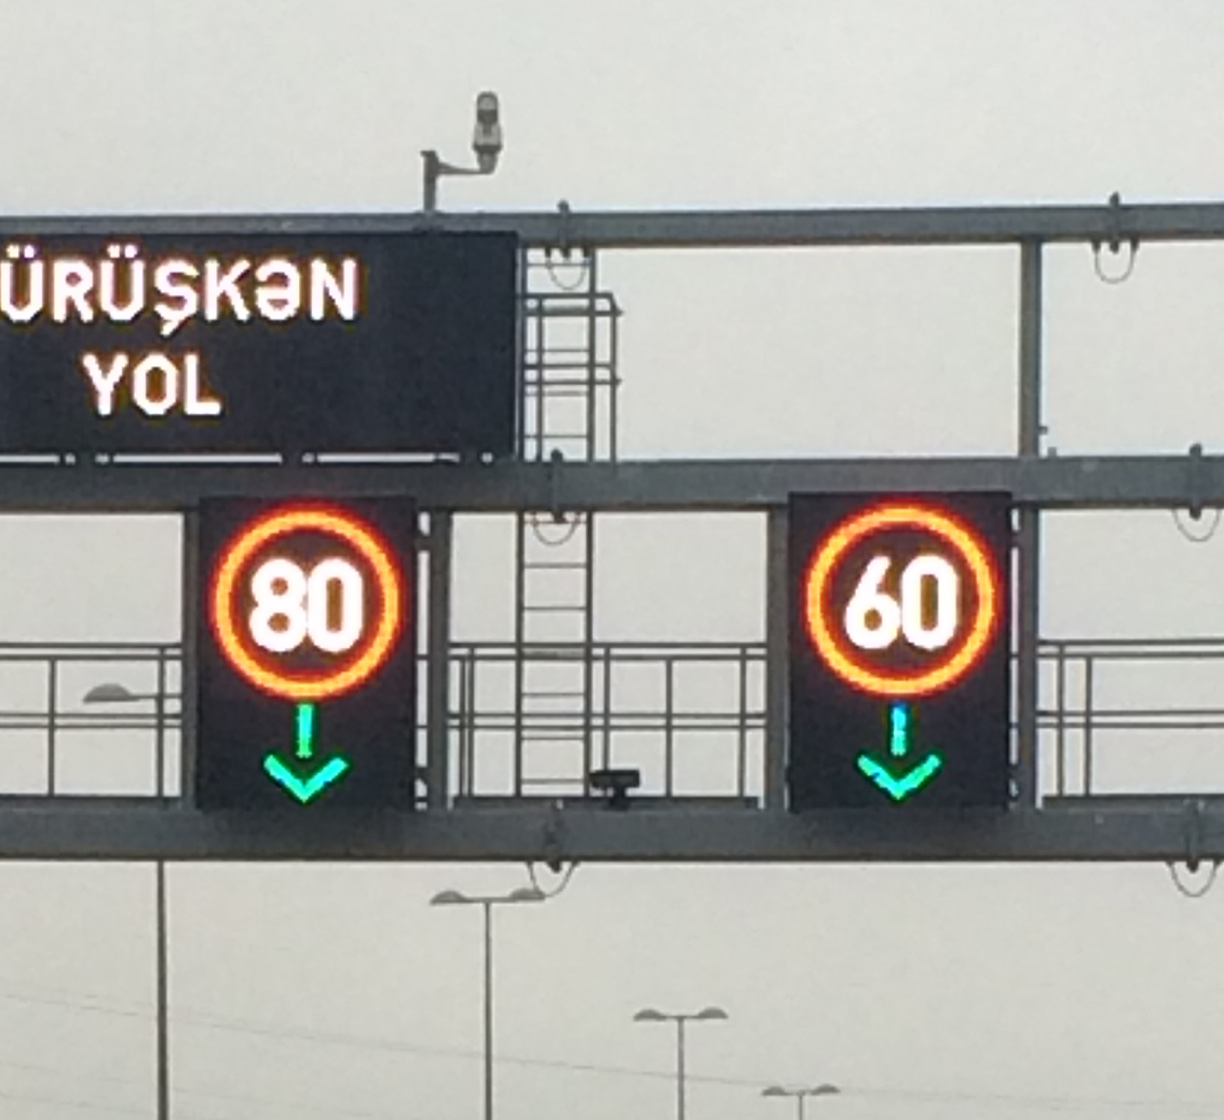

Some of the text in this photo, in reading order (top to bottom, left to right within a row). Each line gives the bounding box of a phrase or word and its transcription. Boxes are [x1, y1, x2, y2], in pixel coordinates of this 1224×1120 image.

[83, 352, 221, 415] YOL
[248, 557, 364, 653] 80
[843, 554, 959, 651] 60
